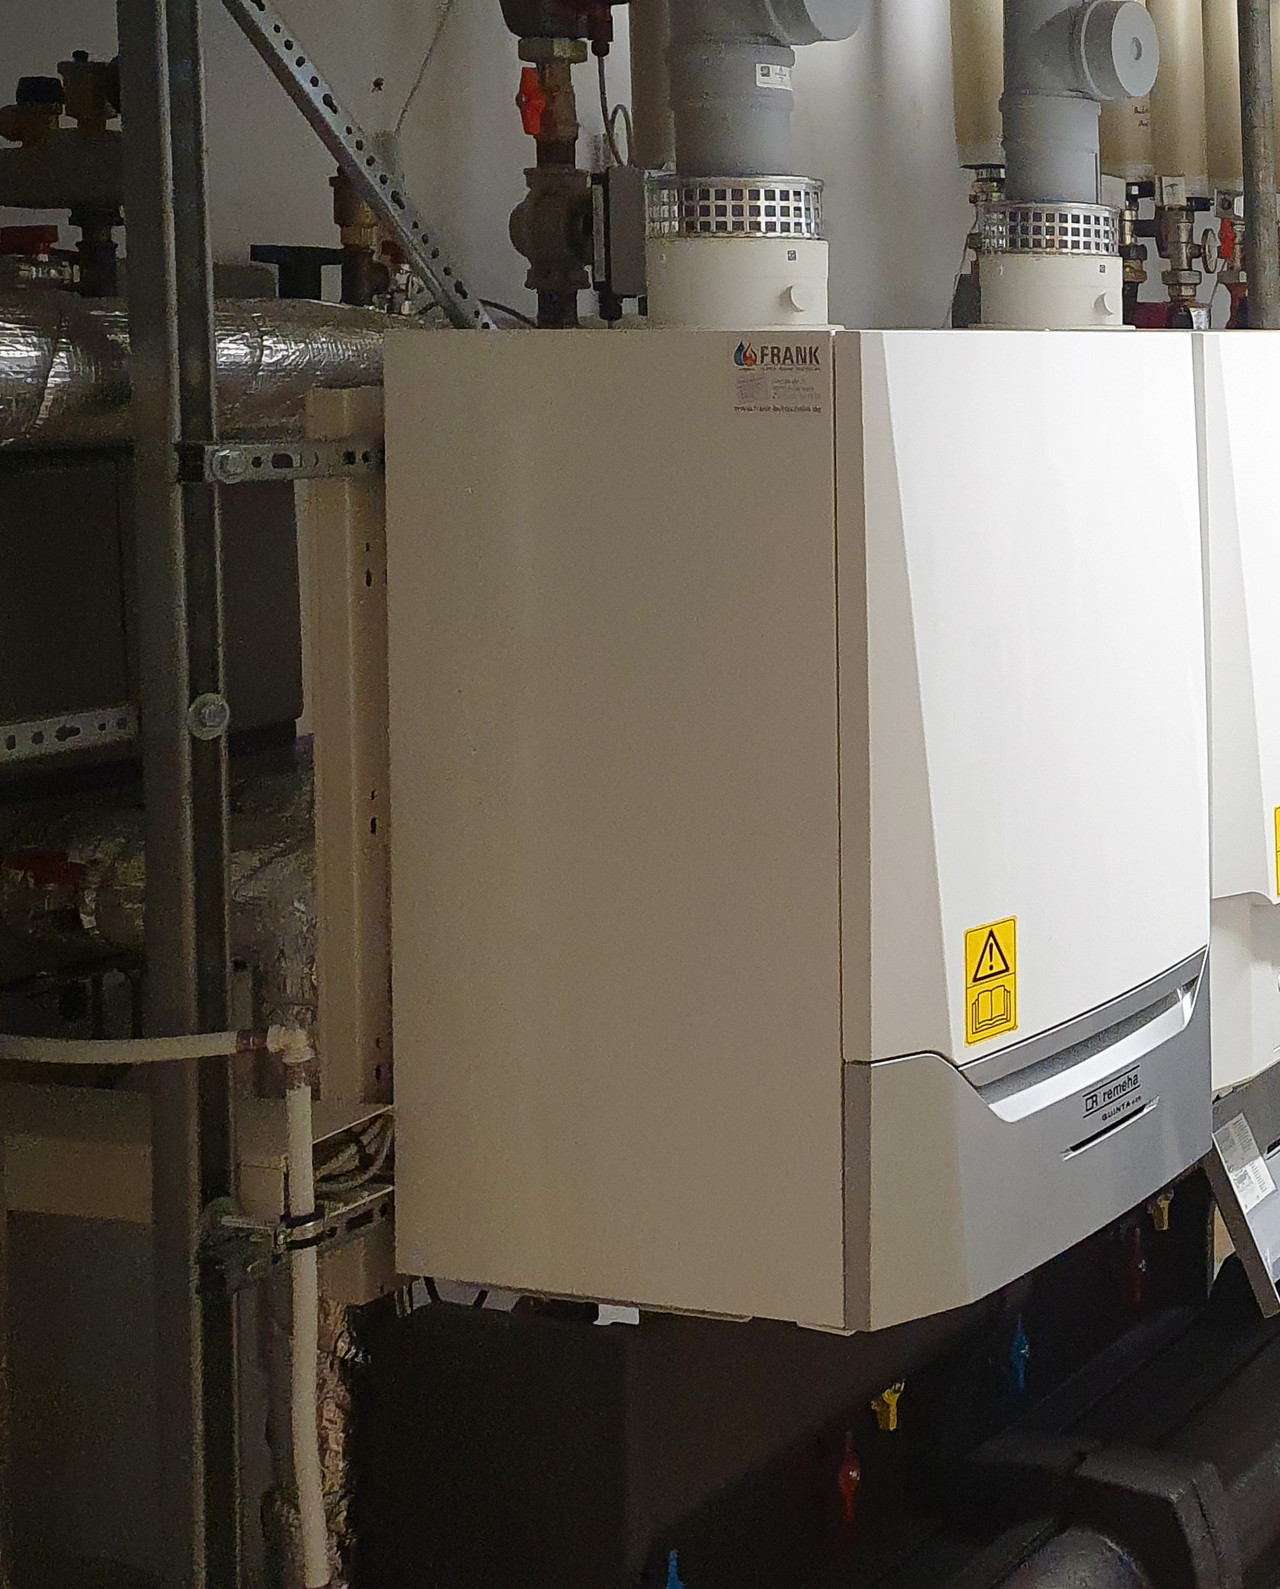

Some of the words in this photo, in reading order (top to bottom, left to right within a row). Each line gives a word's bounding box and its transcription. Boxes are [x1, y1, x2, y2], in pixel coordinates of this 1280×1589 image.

[760, 345, 820, 365] FRANK
[1103, 1073, 1139, 1102] remeha
[1101, 1100, 1131, 1121] QUINTA
